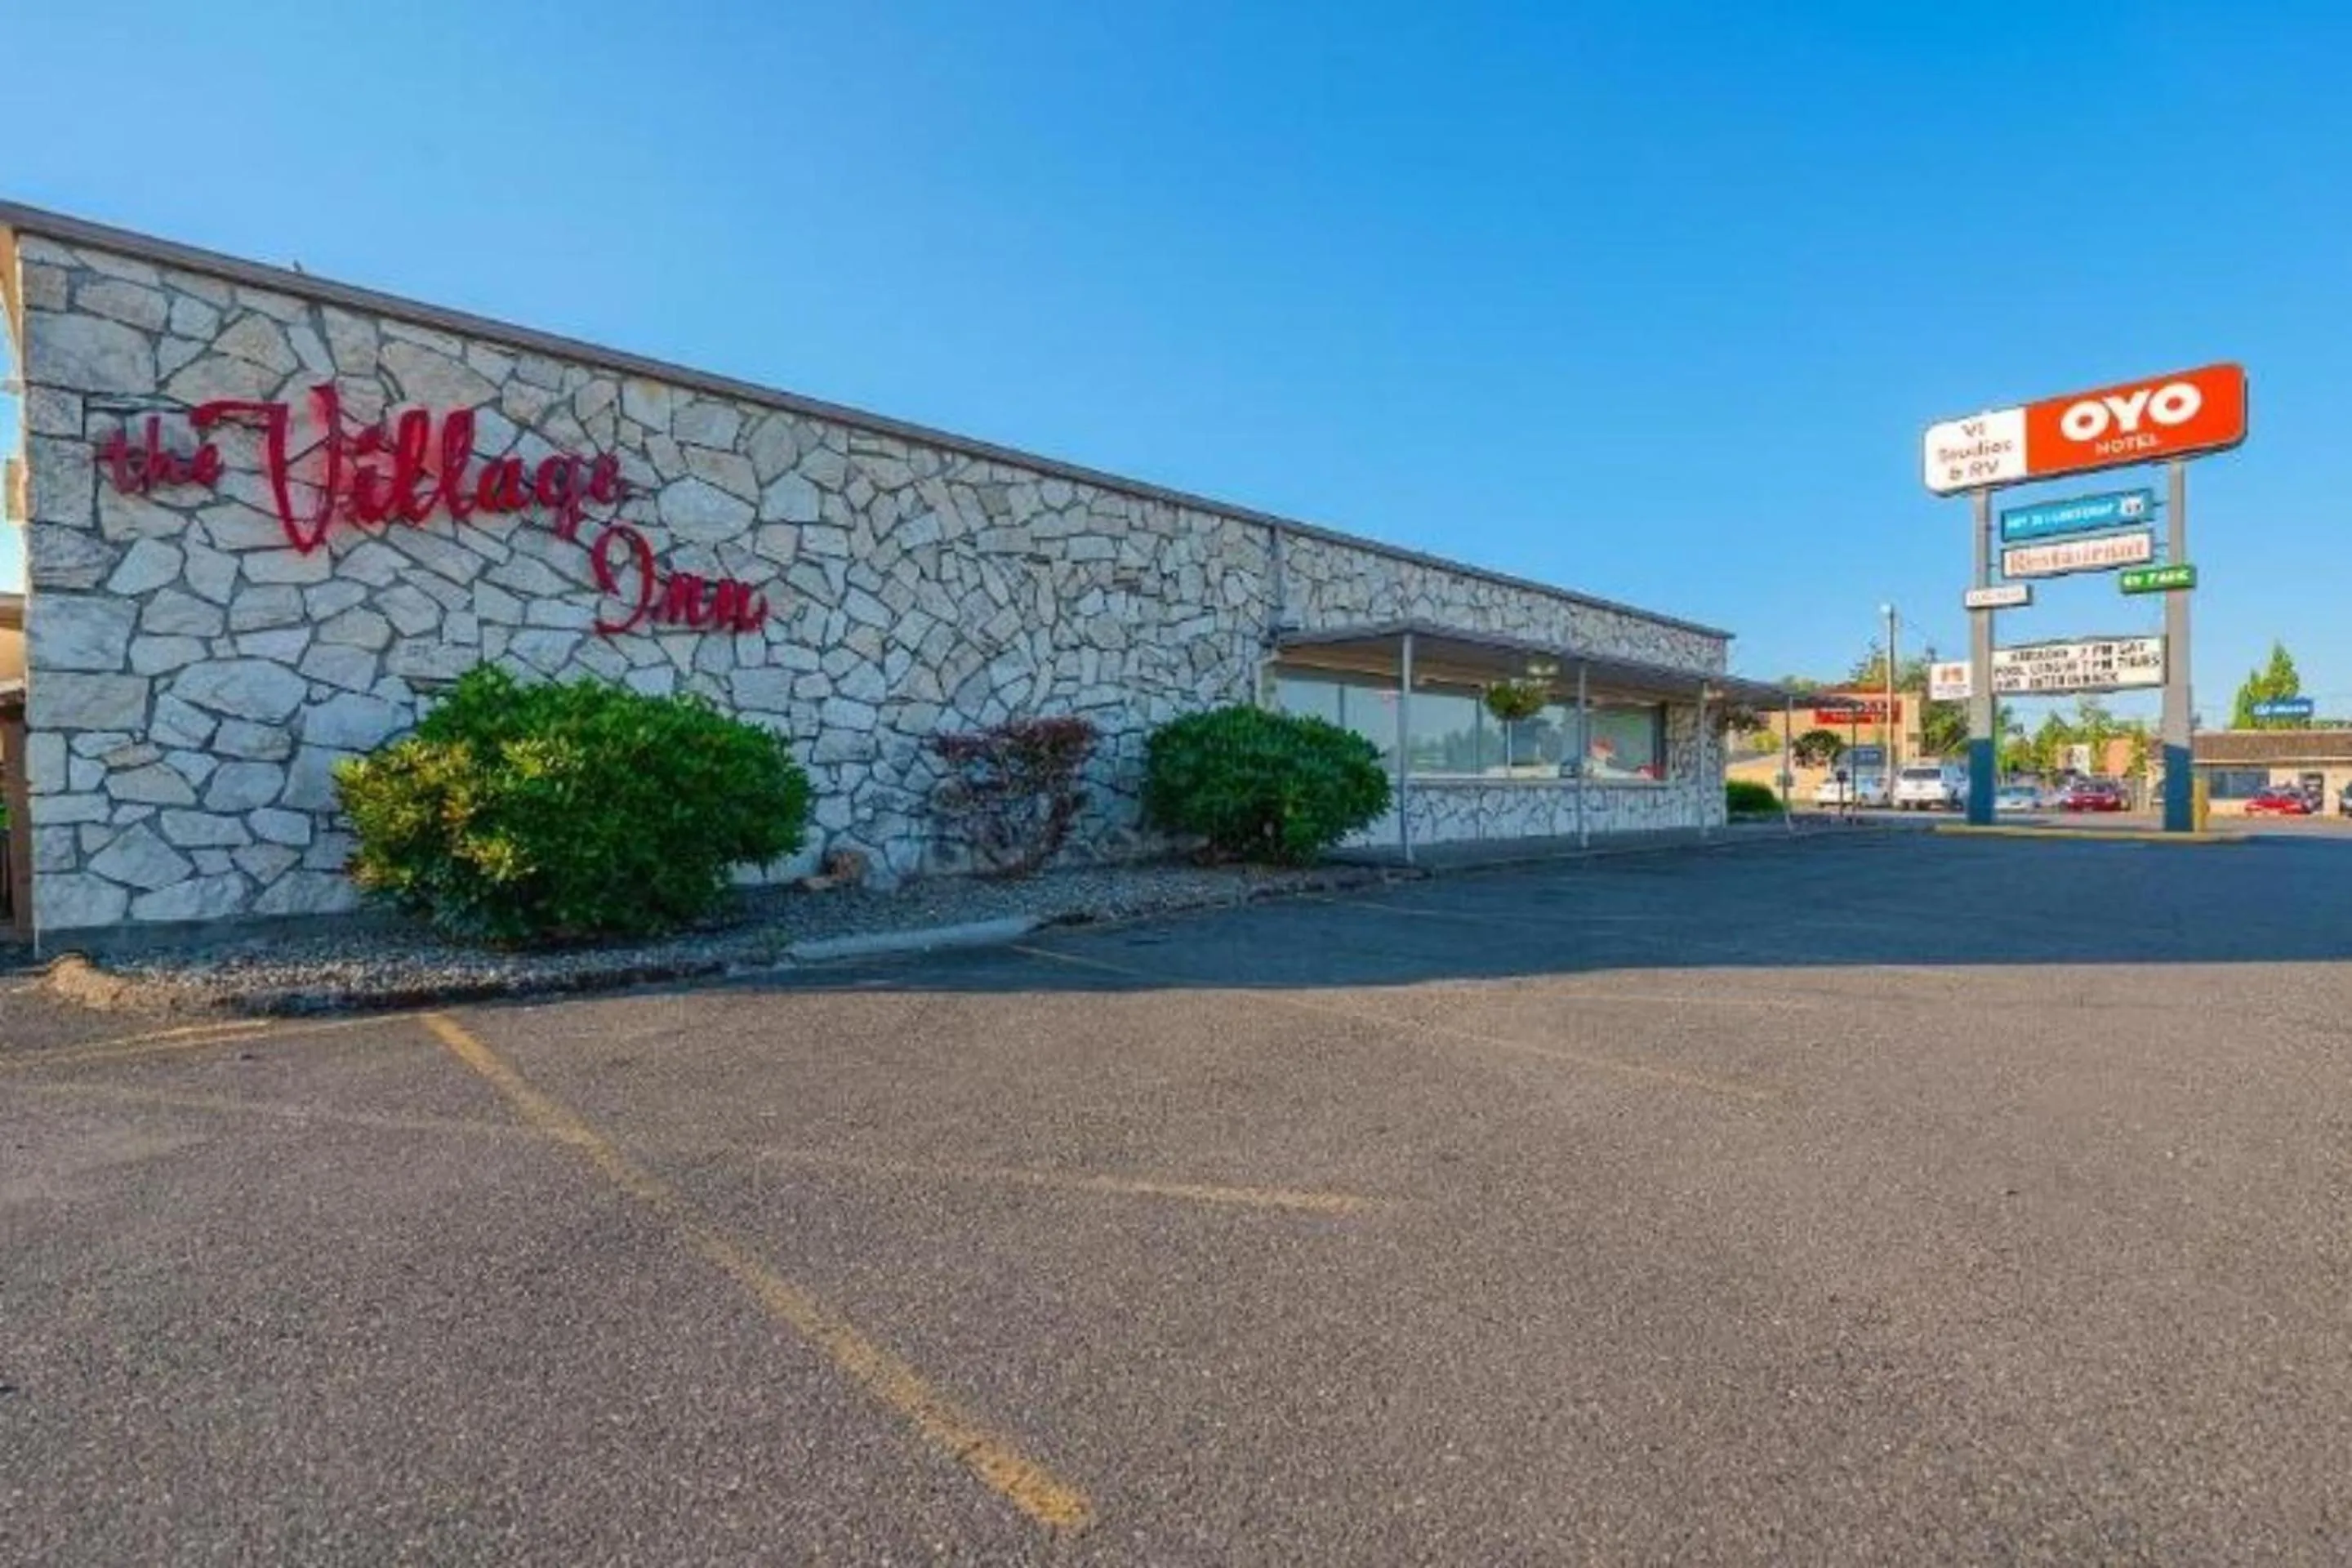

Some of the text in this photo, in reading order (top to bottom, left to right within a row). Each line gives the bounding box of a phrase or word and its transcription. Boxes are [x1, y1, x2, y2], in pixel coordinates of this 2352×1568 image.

[2060, 381, 2202, 441] OYO
[98, 384, 627, 555] the Village
[591, 526, 768, 635] Inn
